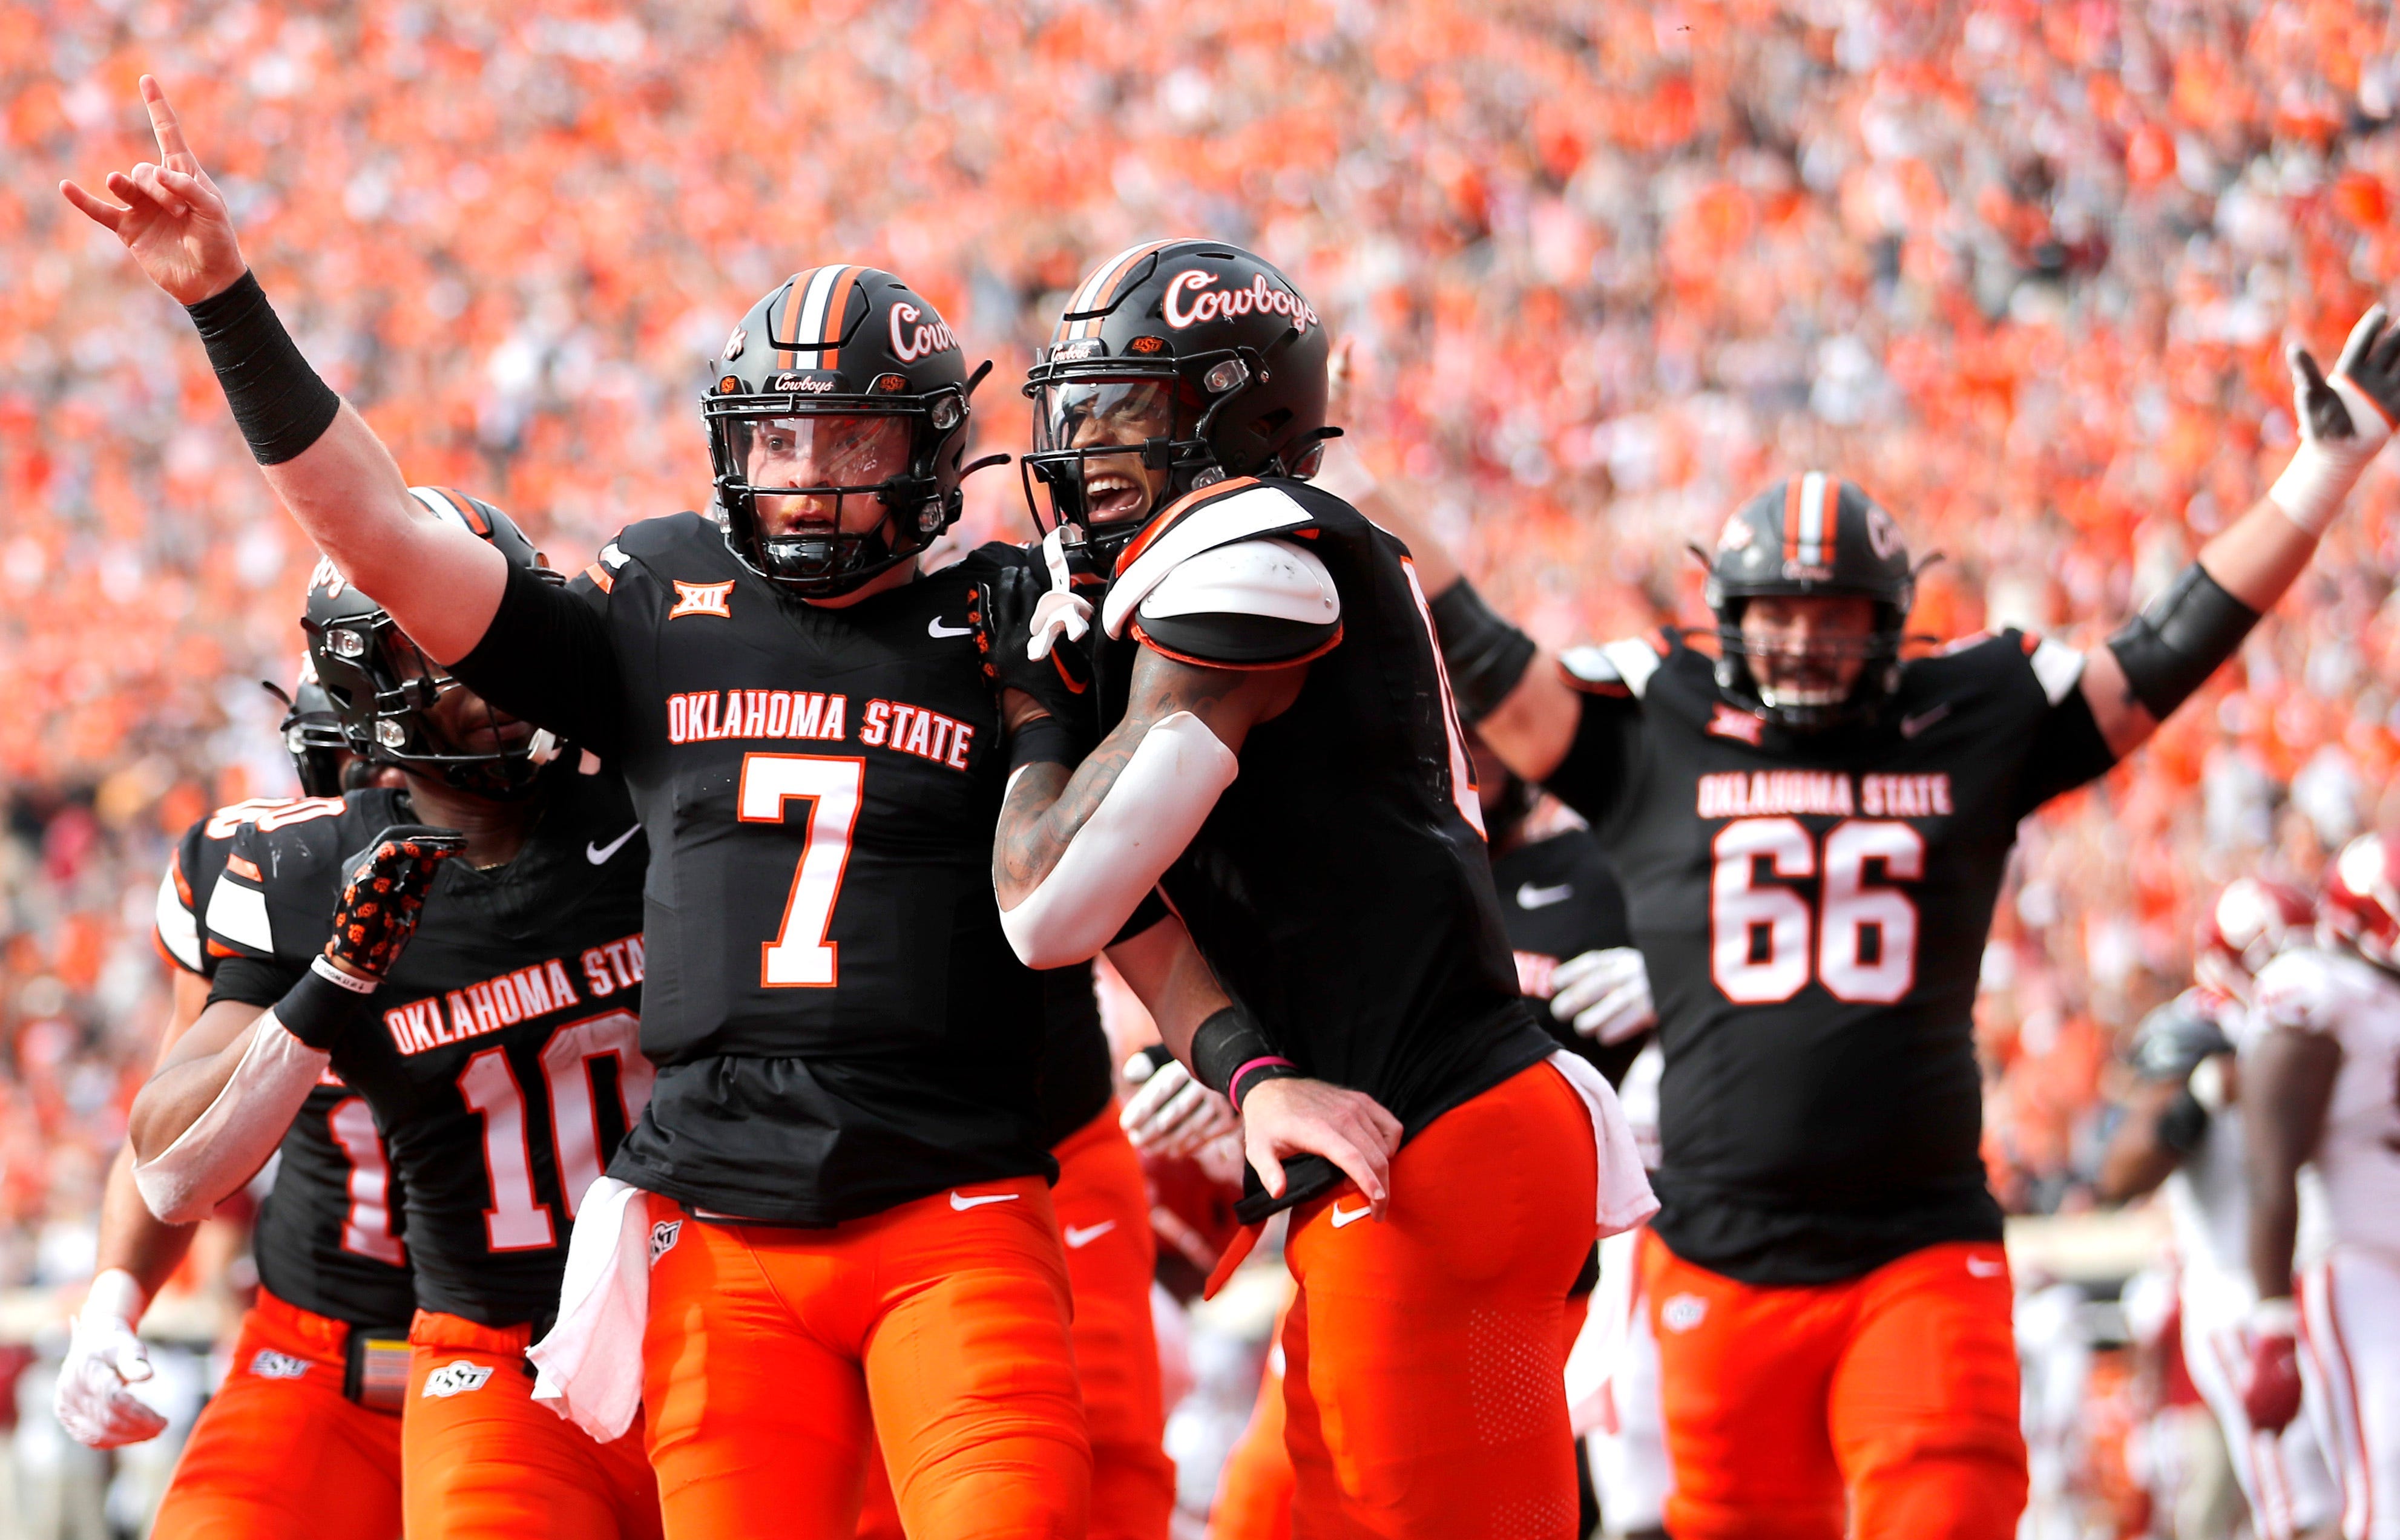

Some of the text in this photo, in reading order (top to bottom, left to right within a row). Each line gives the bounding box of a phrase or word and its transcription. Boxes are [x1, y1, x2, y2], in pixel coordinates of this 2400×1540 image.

[1163, 270, 1318, 333] Cowboys
[775, 372, 834, 393] Cowboys
[669, 580, 735, 620] XII
[667, 689, 975, 771] OKLAHOMA STATE
[1697, 772, 1952, 818] OKLAHOMA STATE
[738, 752, 866, 988] 7
[1710, 816, 1925, 1005] 66
[383, 958, 580, 1057] OKLAHOMA
[456, 1008, 657, 1251] 10
[421, 1360, 495, 1398] OSU
